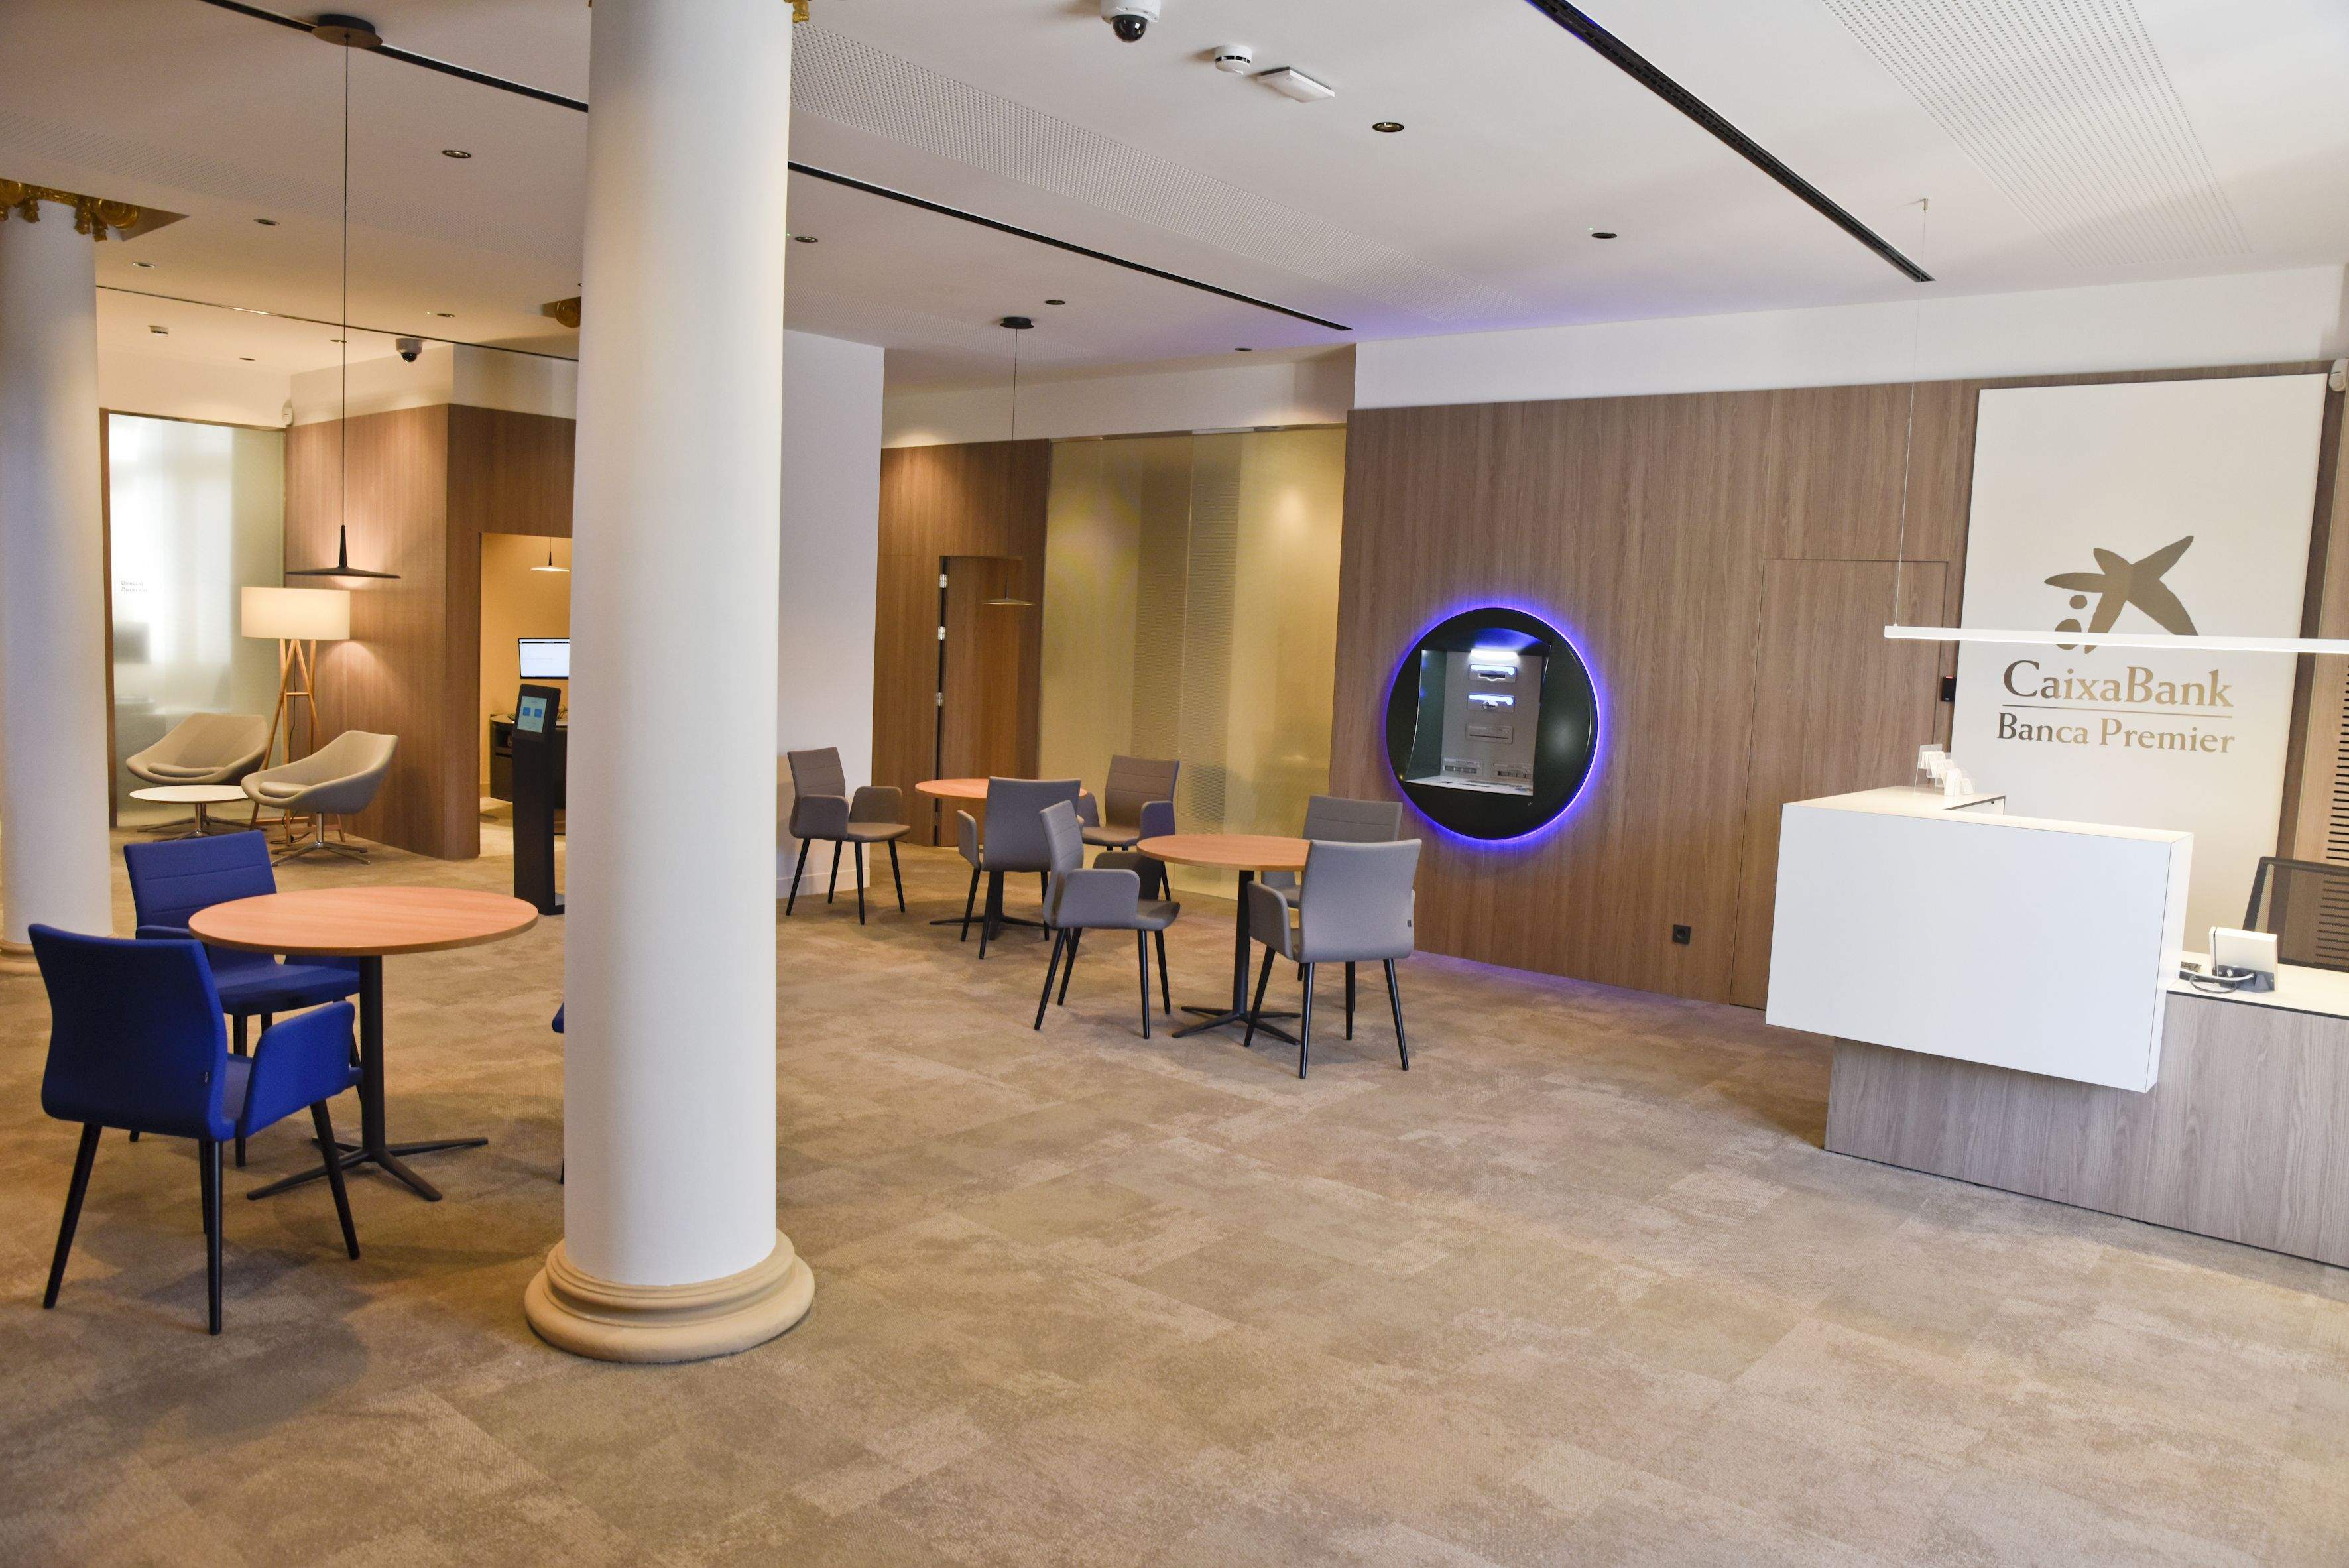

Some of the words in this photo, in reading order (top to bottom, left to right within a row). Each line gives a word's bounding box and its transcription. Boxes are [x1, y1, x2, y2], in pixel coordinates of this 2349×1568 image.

[2003, 660, 2234, 707] CaixaBank
[1997, 711, 2089, 744] Banca
[2099, 718, 2235, 753] Premier
